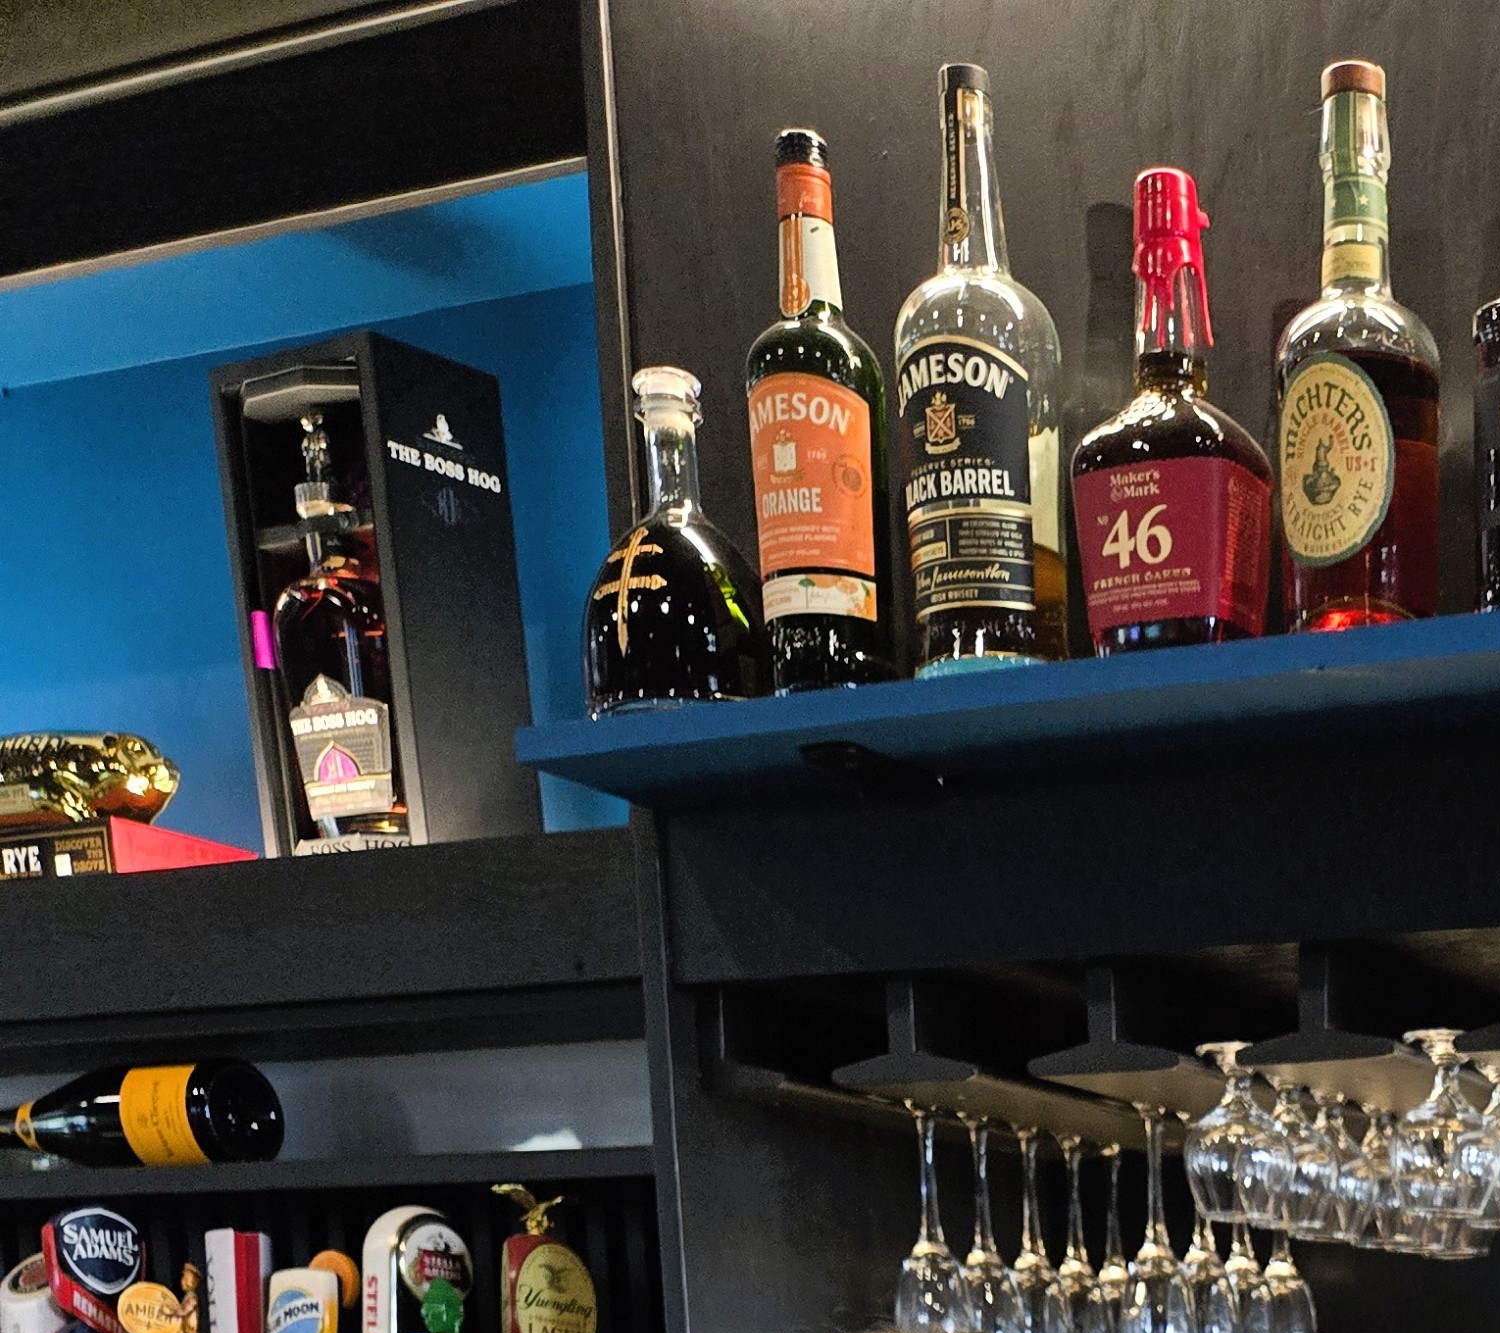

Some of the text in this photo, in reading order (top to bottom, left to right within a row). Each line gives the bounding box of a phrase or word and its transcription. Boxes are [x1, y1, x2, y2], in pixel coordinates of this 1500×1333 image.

[750, 392, 851, 437] AMESON
[387, 440, 502, 494] THE BOSS HOG
[1110, 469, 1160, 488] Maker's
[940, 468, 1015, 498] BARREL
[1124, 481, 1160, 498] Mark
[1348, 477, 1375, 517] RYE
[762, 487, 823, 519] ORANGE
[1102, 503, 1173, 569] 46
[2, 845, 42, 875] RYE
[63, 1223, 139, 1253] SAMUEL
[72, 1241, 135, 1267] ADAMS
[283, 1302, 321, 1324] MOON
[518, 1283, 595, 1320] Yuengling
